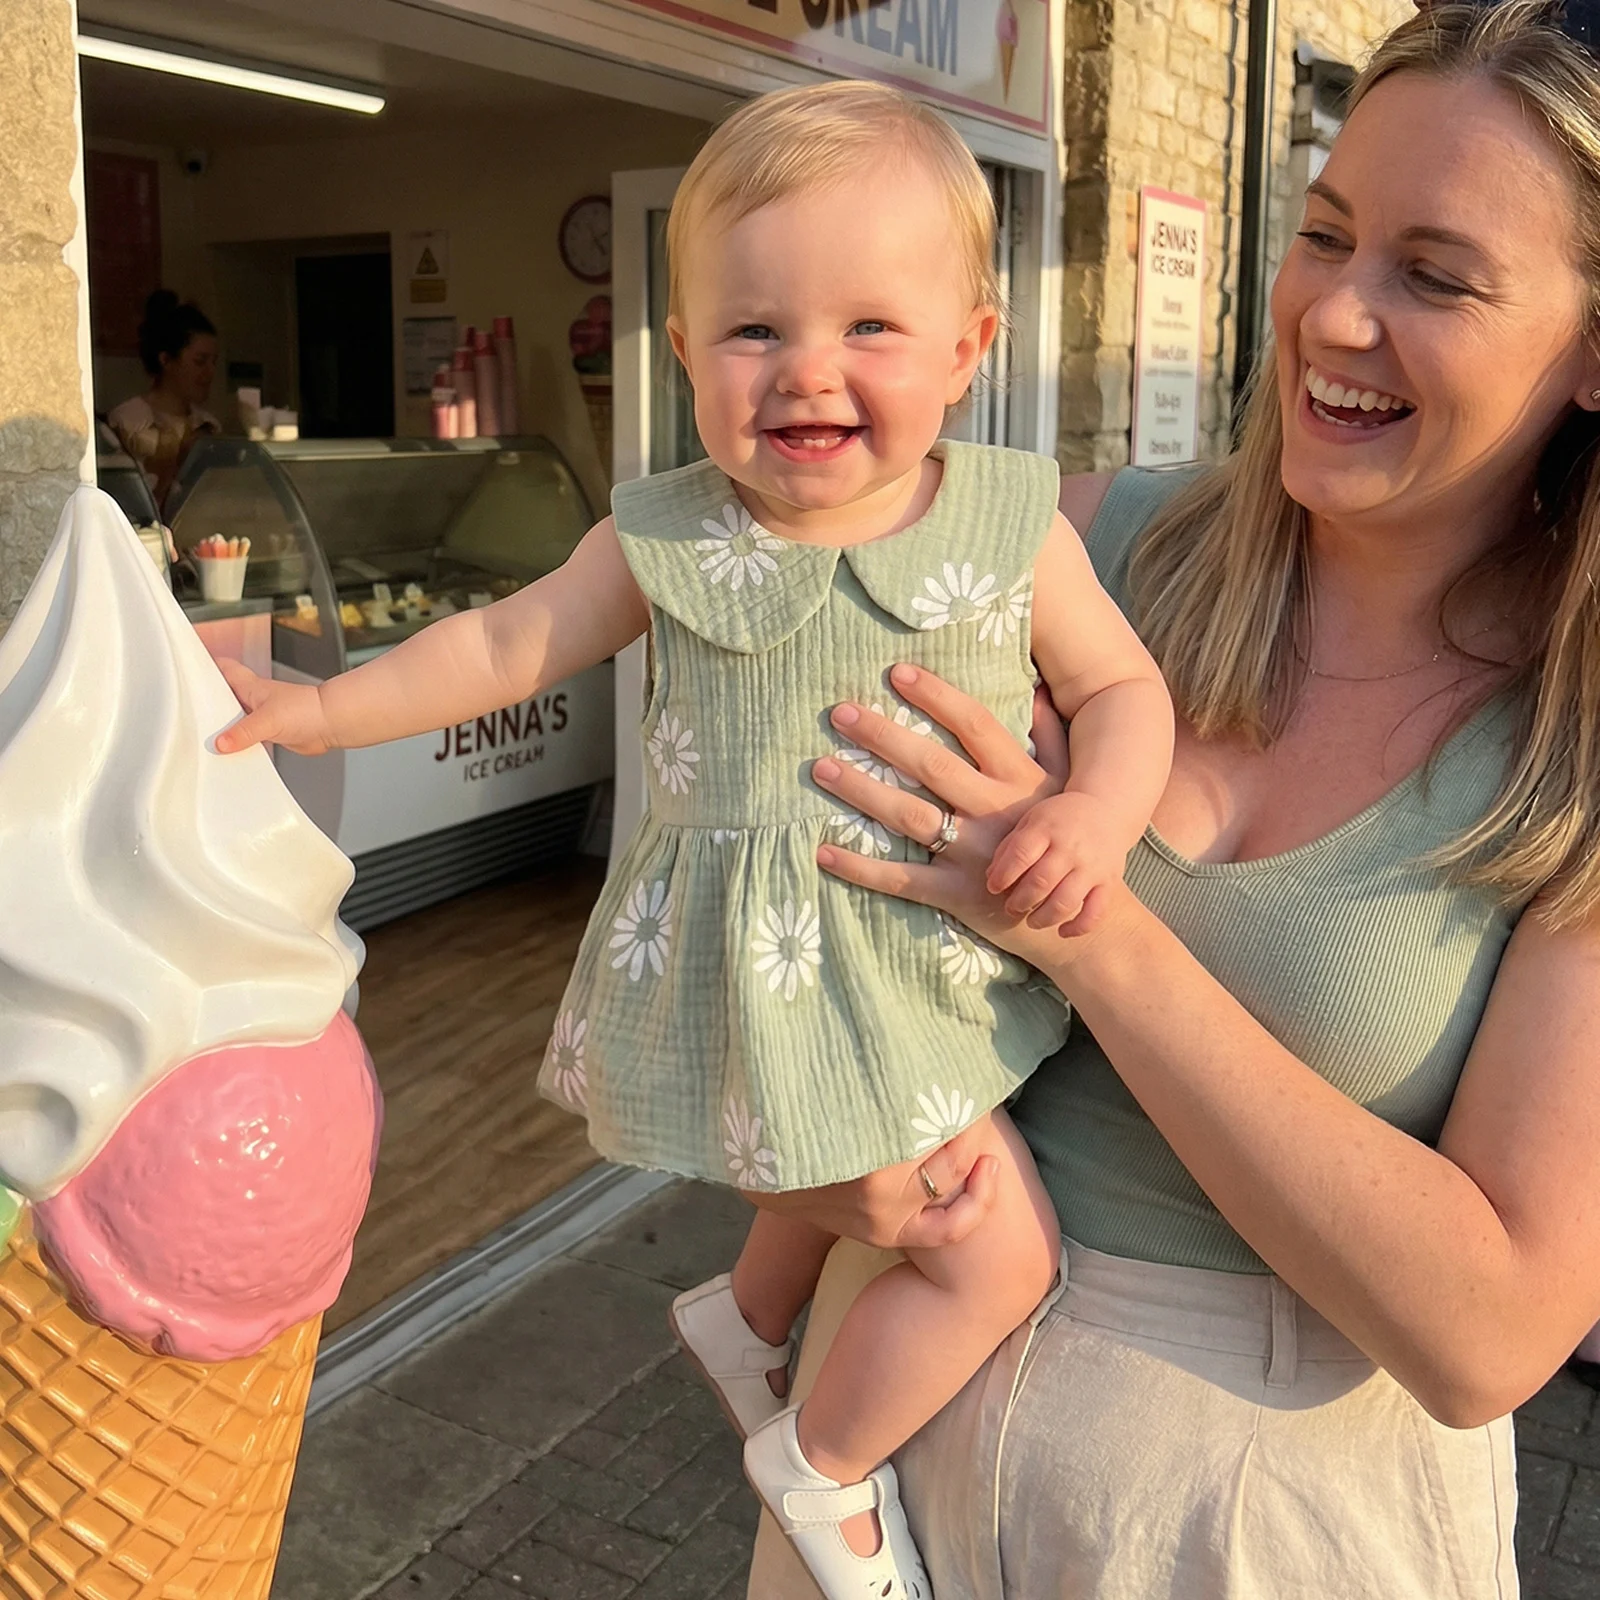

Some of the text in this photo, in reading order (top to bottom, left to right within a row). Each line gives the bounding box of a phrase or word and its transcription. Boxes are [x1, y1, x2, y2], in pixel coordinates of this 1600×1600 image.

[1151, 220, 1197, 255] JENNA'S
[1151, 256, 1166, 275] ICE
[434, 692, 568, 762] JENNA'S
[463, 743, 545, 782] ICE CREAM
